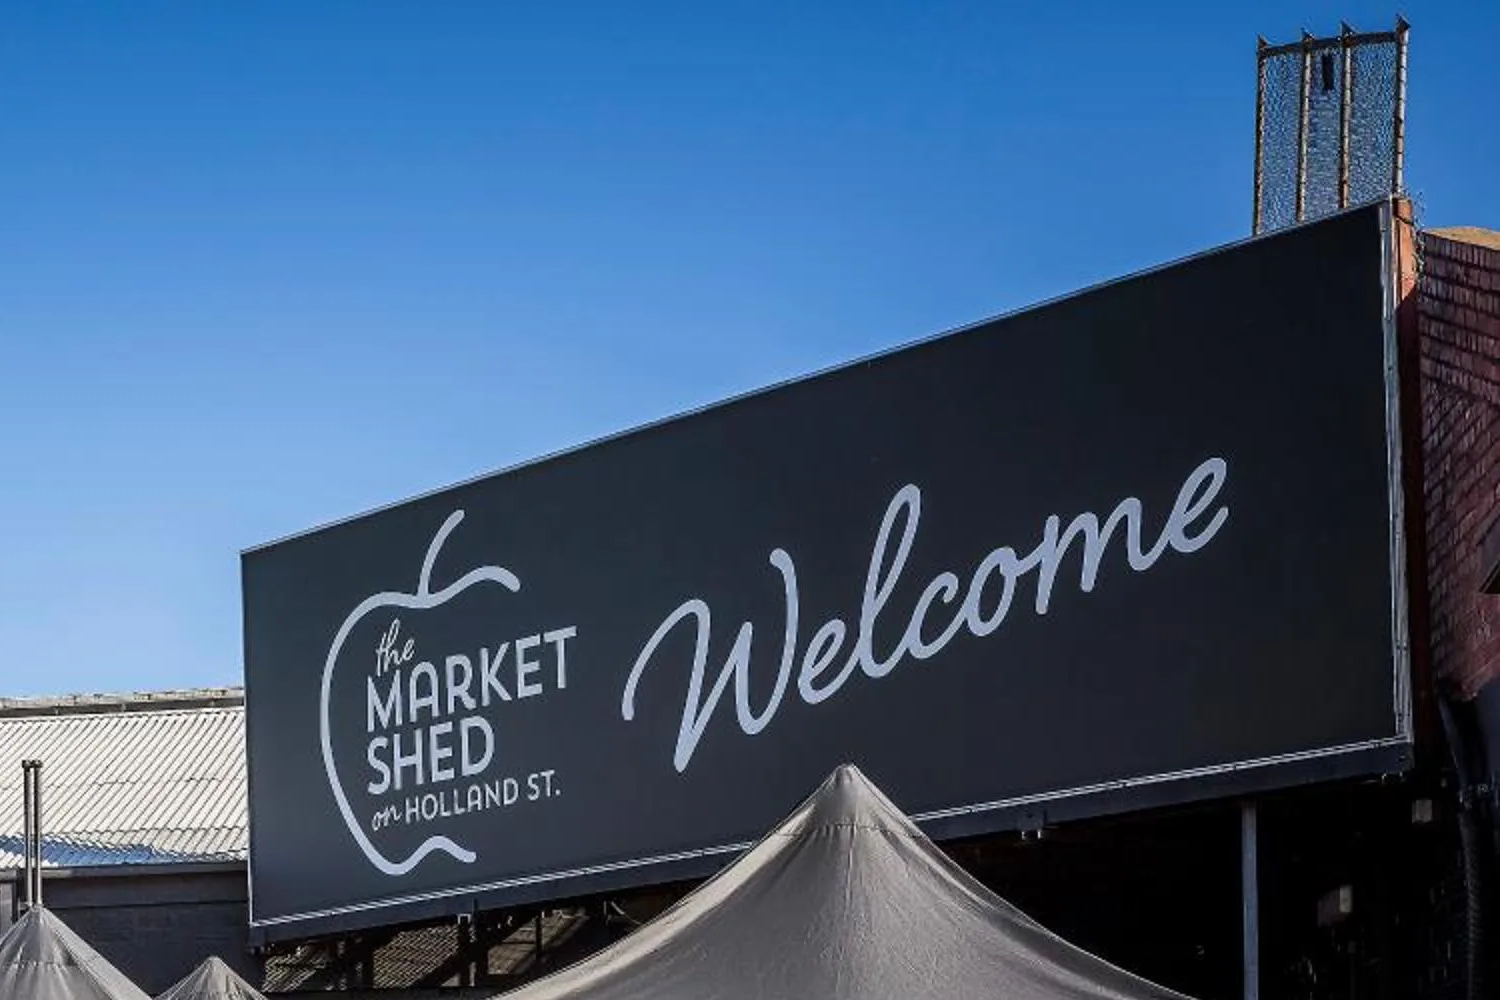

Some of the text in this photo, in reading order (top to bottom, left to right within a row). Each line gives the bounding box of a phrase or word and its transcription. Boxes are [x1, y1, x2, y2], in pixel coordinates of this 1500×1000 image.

[375, 617, 416, 677] the
[621, 457, 1229, 773] Welcome
[366, 625, 578, 733] MARKET
[366, 714, 496, 796] SHED
[370, 768, 562, 832] on HOLLAND ST.
